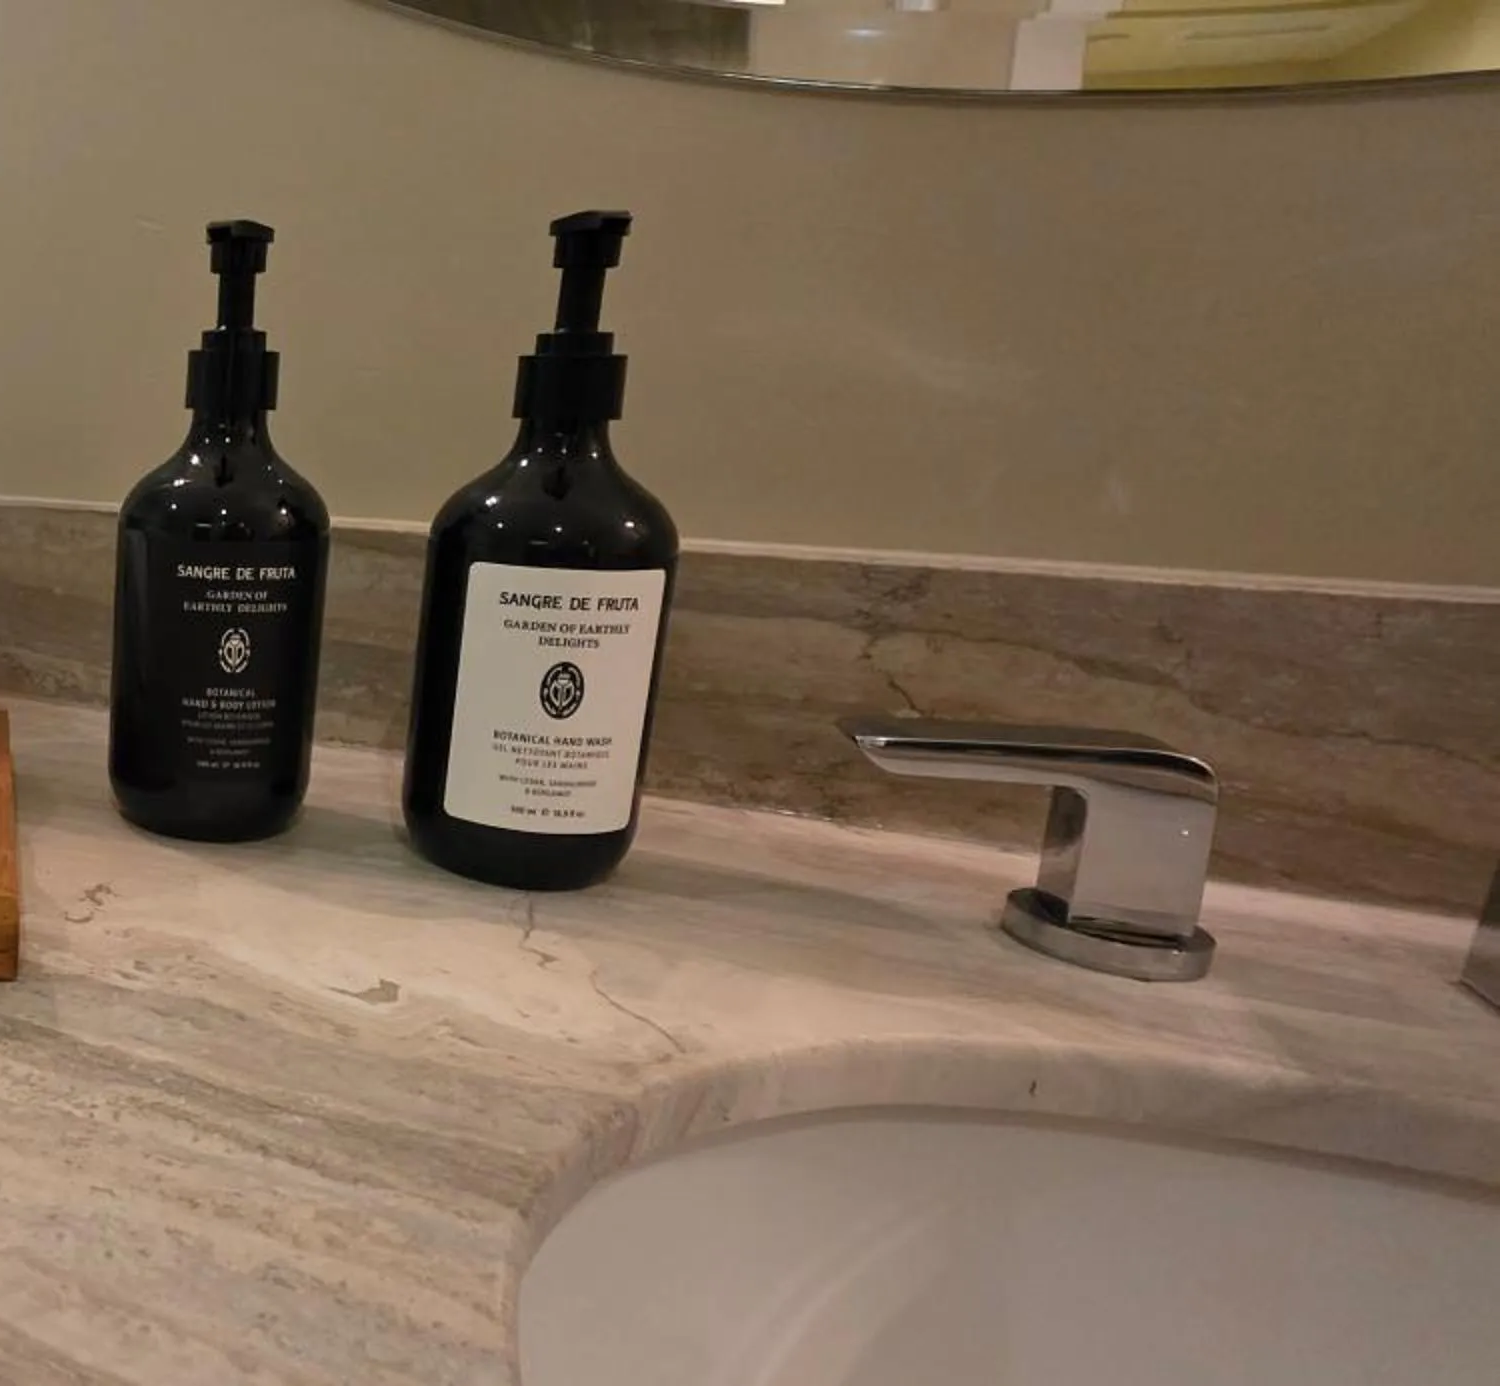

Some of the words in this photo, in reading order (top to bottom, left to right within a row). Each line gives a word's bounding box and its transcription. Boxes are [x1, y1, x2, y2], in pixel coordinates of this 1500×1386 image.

[176, 564, 230, 580] SANGRE
[235, 567, 254, 581] DE
[259, 567, 296, 580] FRUTA
[206, 590, 251, 601] GARDEN
[499, 591, 562, 609] SANGRE
[569, 597, 591, 611] DE
[596, 597, 639, 611] FRUTA
[503, 619, 556, 633] GARDEN
[559, 624, 577, 634] OF
[579, 624, 631, 635] EARTHLY
[538, 636, 600, 649] DELIGHTS
[493, 729, 550, 745] BOTANICAL
[553, 736, 584, 746] HAND
[586, 736, 613, 747] WASH
